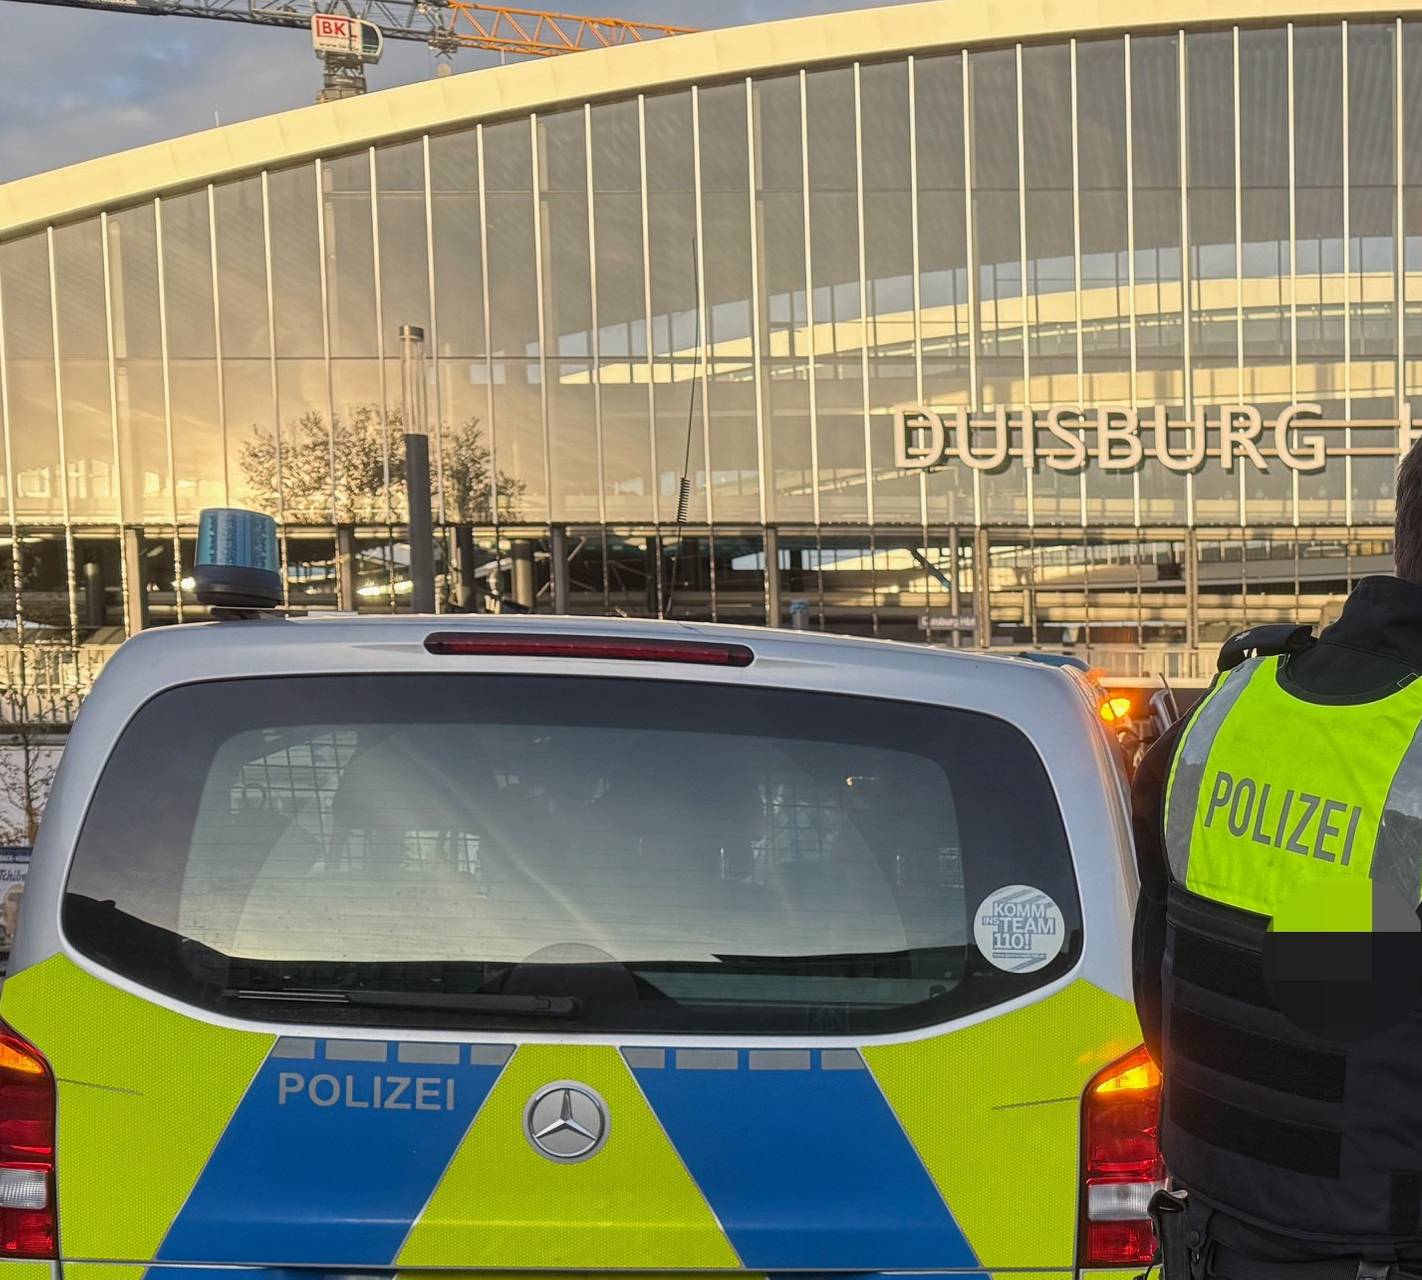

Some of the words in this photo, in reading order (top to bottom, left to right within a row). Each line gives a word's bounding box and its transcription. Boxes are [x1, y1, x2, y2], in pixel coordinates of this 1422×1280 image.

[893, 403, 1327, 471] DUISBURG
[1204, 771, 1362, 867] POLIZEI
[994, 902, 1046, 918] KOMM
[983, 917, 1000, 926] INS
[1001, 918, 1055, 934] TEAM
[994, 933, 1030, 949] 110!
[278, 1072, 454, 1110] POLIZEI
